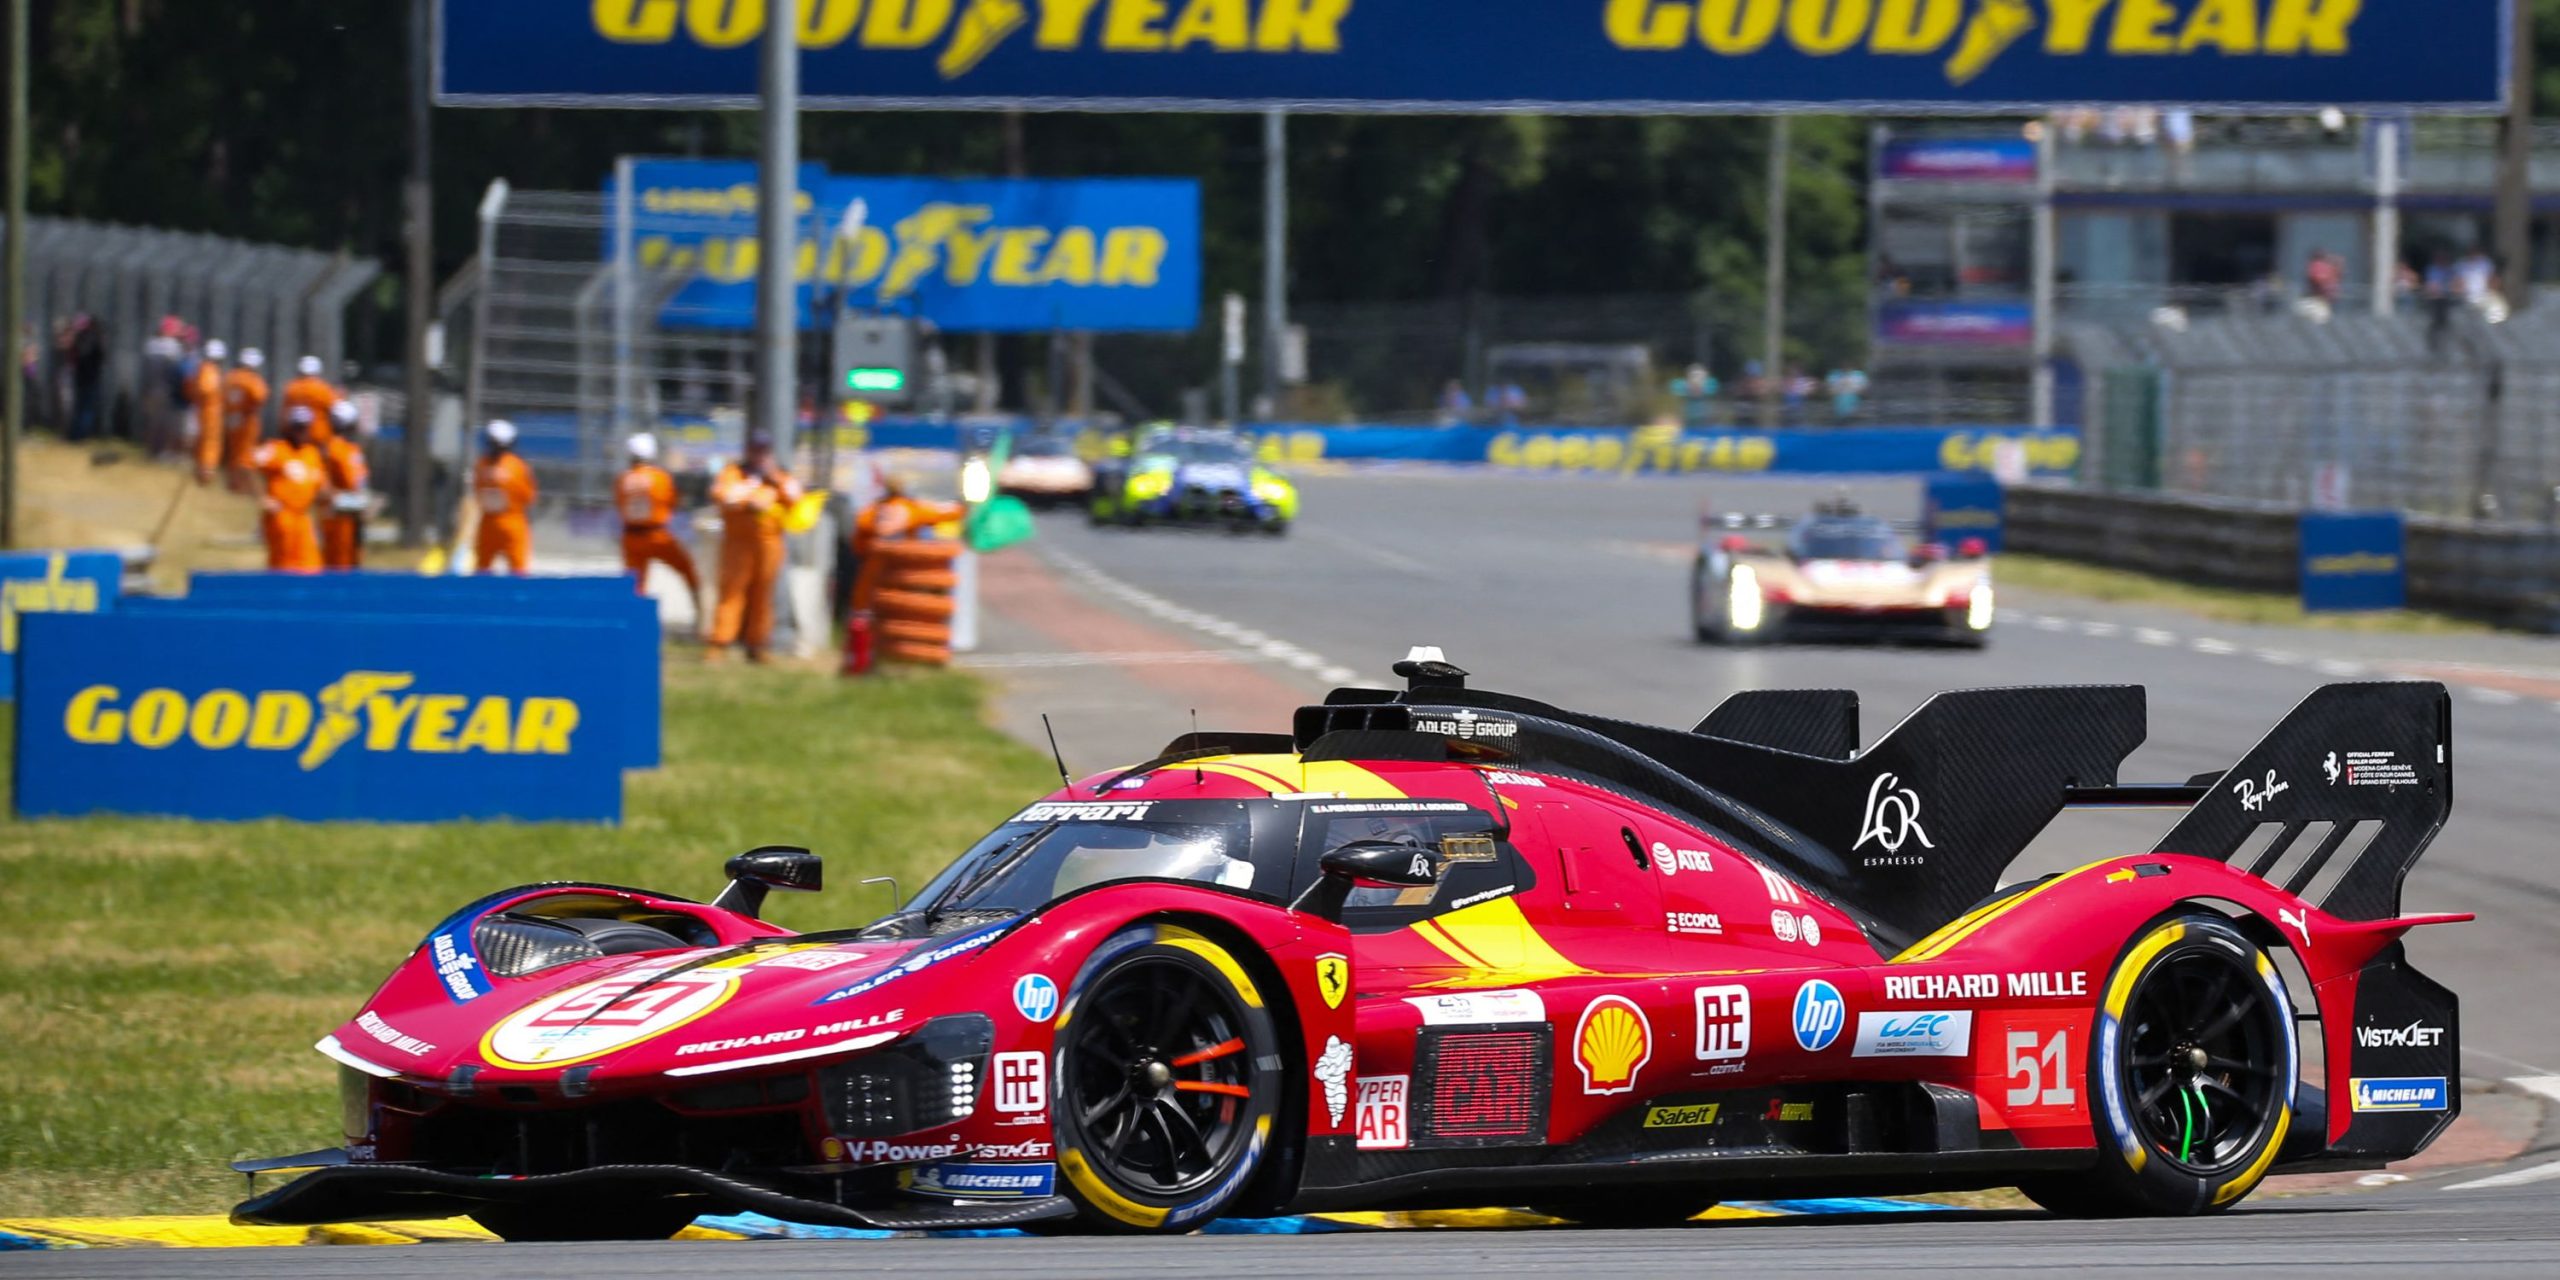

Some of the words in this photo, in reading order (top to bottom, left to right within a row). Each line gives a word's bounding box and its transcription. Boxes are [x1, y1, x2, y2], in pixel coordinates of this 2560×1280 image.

[591, 0, 1351, 53] GOODYEAR
[1605, 0, 2361, 55] GOODYEAR
[64, 685, 579, 754] GOODYEAR
[1416, 720, 1457, 735] ADLER
[1476, 723, 1517, 737] GROUP
[1677, 850, 1713, 872] AT&T
[1864, 857, 1924, 867] ESPRESSO
[1678, 913, 1721, 929] ECOPOL
[446, 971, 479, 1000] GROUP
[826, 968, 904, 1001] ADLER
[1022, 975, 1054, 1021] hp
[1885, 974, 2000, 999] RICHARD
[2007, 971, 2087, 996] MILLE
[1798, 981, 1841, 1049] hp
[1880, 1014, 1949, 1037] WEC
[355, 1010, 403, 1043] RICHARD
[388, 1035, 437, 1056] MILLE
[675, 1028, 806, 1056] RICHARD
[813, 1008, 905, 1037] MILLE
[2006, 1029, 2075, 1107] 51
[1444, 1073, 1522, 1123] CAR
[2371, 1086, 2436, 1102] MICHELIN
[1652, 1105, 1710, 1127] Sabelt
[846, 1140, 955, 1161] V-Power
[945, 1174, 1044, 1188] MICHELIN
